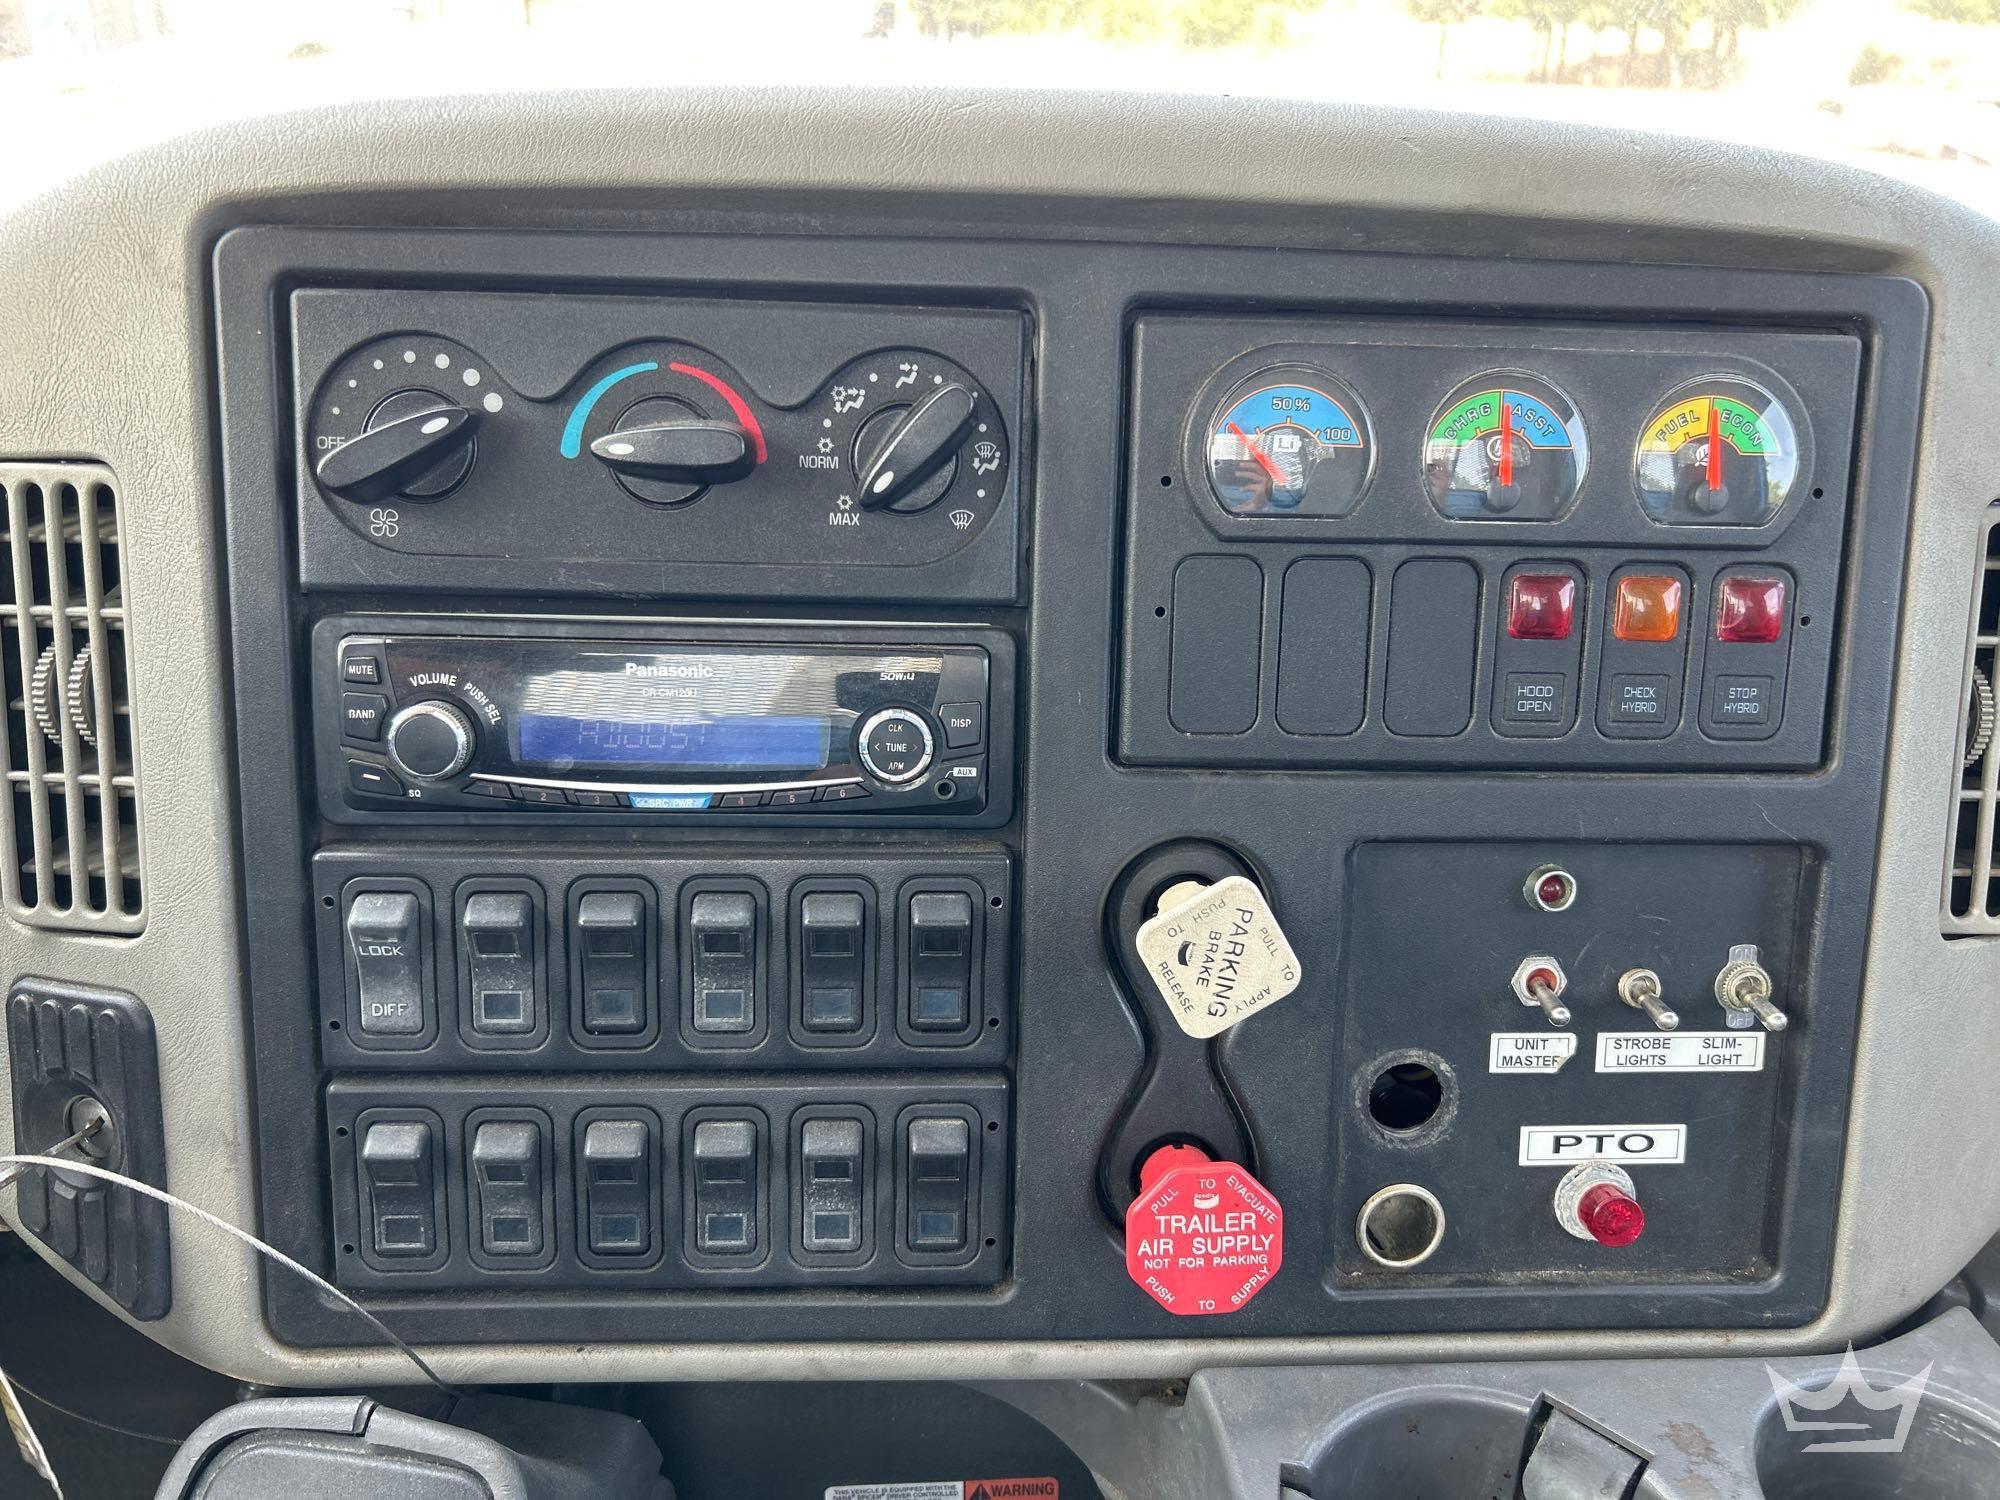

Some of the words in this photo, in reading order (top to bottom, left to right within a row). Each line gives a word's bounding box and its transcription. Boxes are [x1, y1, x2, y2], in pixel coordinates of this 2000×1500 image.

[1271, 397, 1310, 412] 50%
[1443, 403, 1492, 441] CHRG
[1512, 404, 1556, 438] ASST
[1656, 410, 1700, 443] FUEL
[1323, 427, 1351, 441] 100
[1720, 411, 1764, 447] ECON
[317, 436, 346, 449] OFF
[799, 455, 839, 470] NORM
[829, 512, 860, 527] MAX
[348, 664, 373, 675] MUTE
[625, 662, 715, 678] Panasonic
[1517, 686, 1554, 697] HOOD
[1624, 687, 1656, 698] CHECK
[1728, 688, 1758, 699] STOP
[409, 672, 458, 687] VOLUME
[463, 682, 488, 706] PUSH
[485, 704, 502, 726] SEL
[348, 708, 375, 719] BAND
[1517, 701, 1552, 712] OPEN
[1621, 702, 1657, 713] HYBRID
[1723, 703, 1759, 714] HYBRID
[888, 723, 904, 732] CLK
[951, 718, 972, 728] DISP
[885, 742, 907, 753] TUNE
[888, 761, 904, 771] APM
[956, 767, 973, 776] AUX
[408, 788, 422, 798] SQ
[540, 791, 547, 801] 2
[593, 795, 600, 804] 3
[789, 794, 796, 804] 5
[839, 788, 846, 798] 6
[1193, 898, 1226, 924] PUSH
[1167, 924, 1185, 938] TO
[1260, 927, 1279, 957] PULL
[358, 945, 404, 956] LOCK
[1196, 930, 1222, 988] BRAKE
[1206, 907, 1254, 1018] PARKING
[1280, 963, 1295, 981] TO
[1158, 961, 1194, 1014] RELEASE
[1234, 986, 1271, 1014] APPLY
[371, 1003, 408, 1017] DIFF
[1514, 1038, 1549, 1051] UNIT
[1613, 1037, 1672, 1050] STROBE
[1702, 1037, 1742, 1049] SLIM-
[1616, 1054, 1666, 1066] LIGHTS
[1698, 1053, 1742, 1065] LIGHT
[1551, 1133, 1655, 1154] PTO
[1151, 1187, 1179, 1215] PULL
[1198, 1178, 1216, 1190] TO
[1225, 1175, 1279, 1225] EVACUATE
[1154, 1212, 1257, 1235] TRAILER
[1137, 1238, 1174, 1257] AIR
[1191, 1233, 1275, 1255] SUPPLY
[1144, 1258, 1171, 1270] NOT
[1178, 1257, 1205, 1268] FOR
[1213, 1254, 1268, 1267] PARKING
[1145, 1276, 1176, 1305] PUSH
[1198, 1300, 1216, 1311] TO
[1230, 1265, 1271, 1305] SUPPLY
[991, 1483, 1055, 1497] WARNING
